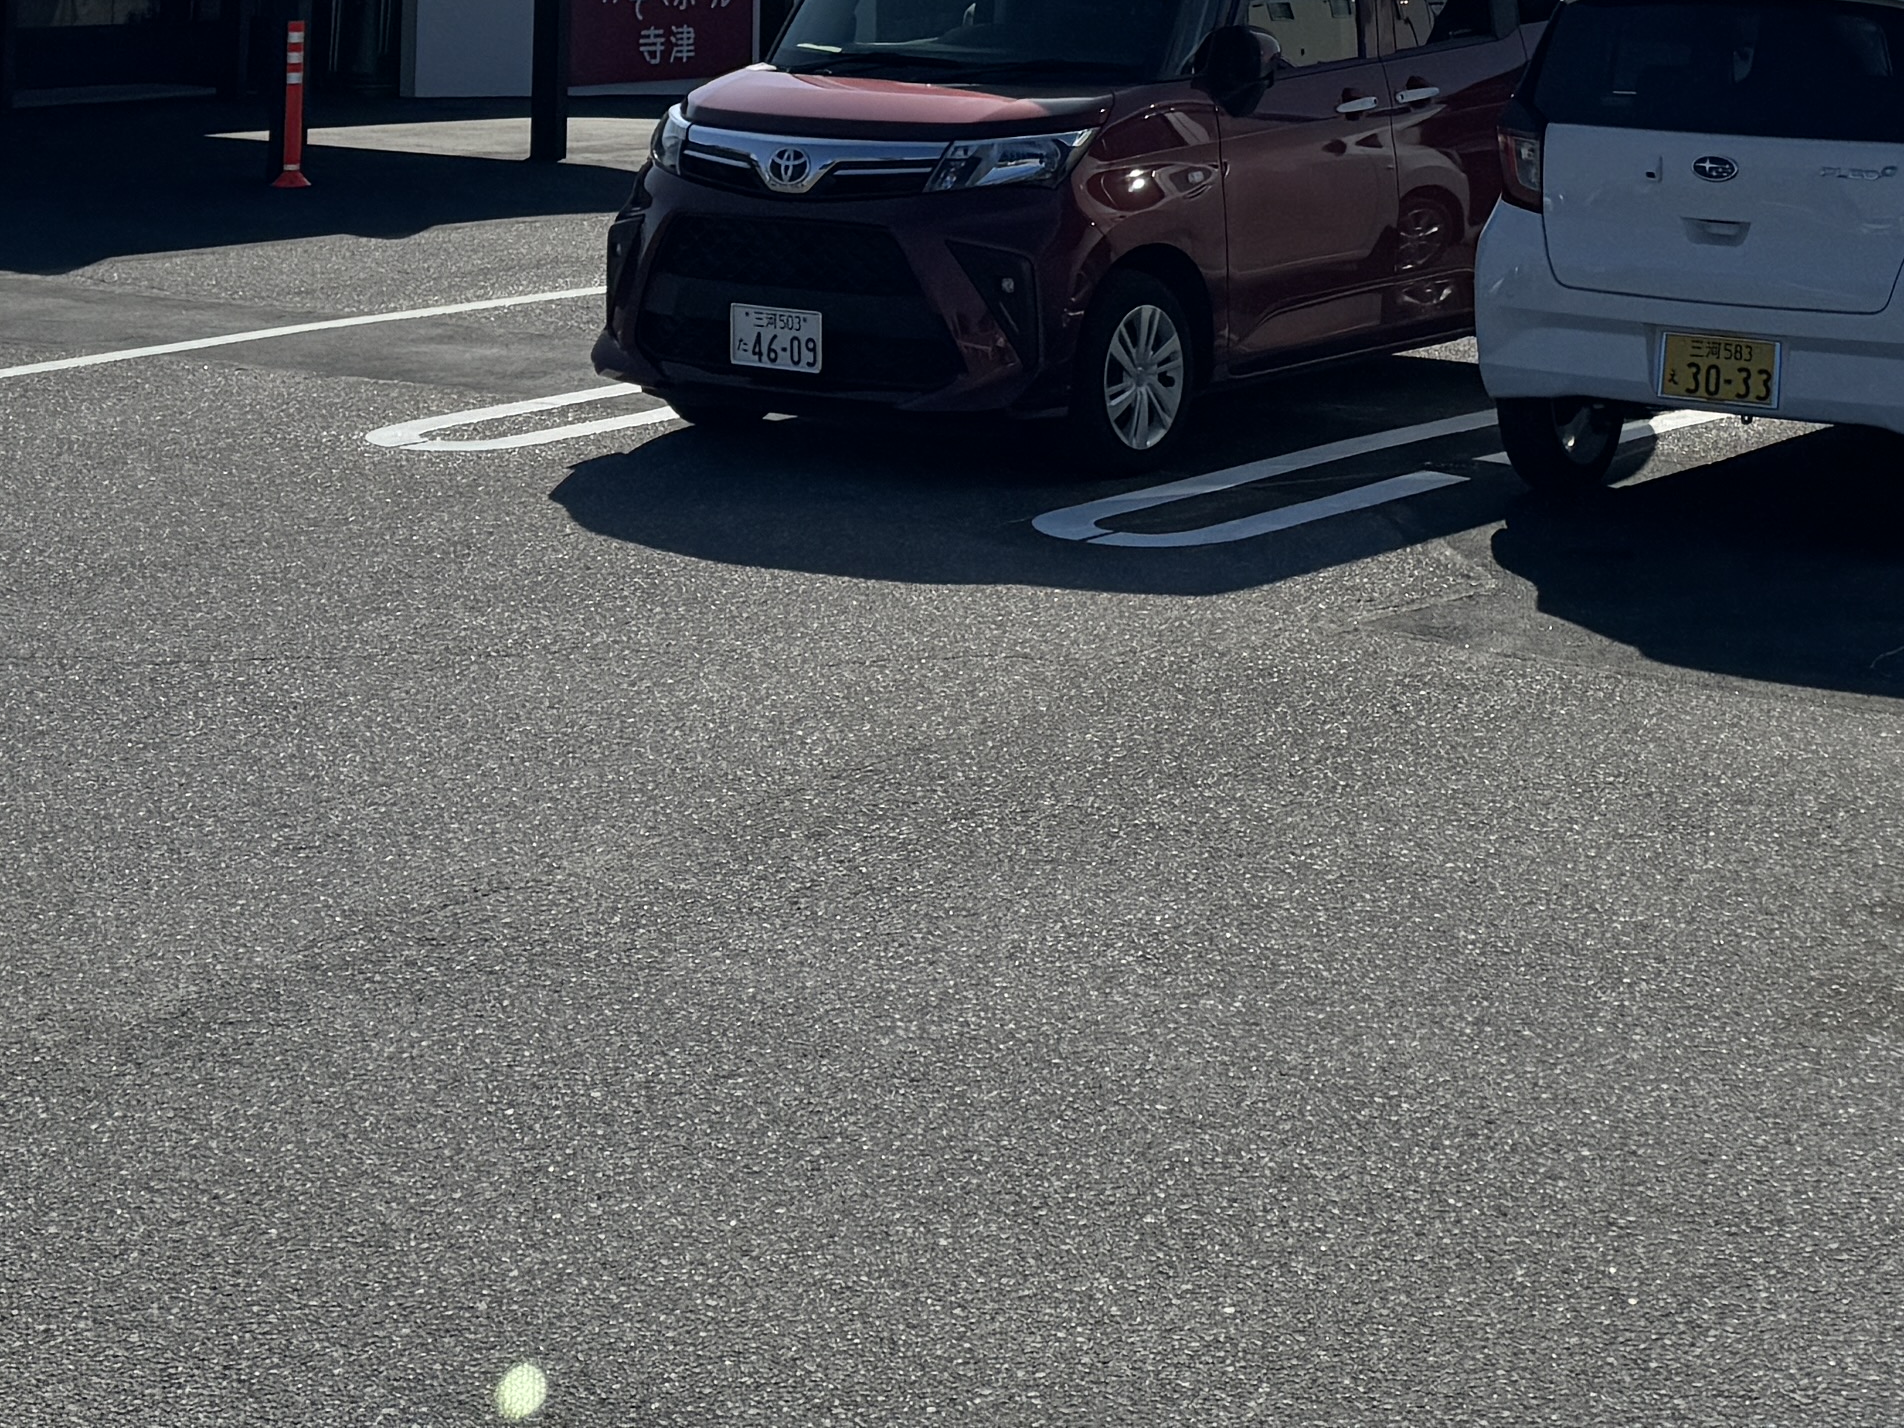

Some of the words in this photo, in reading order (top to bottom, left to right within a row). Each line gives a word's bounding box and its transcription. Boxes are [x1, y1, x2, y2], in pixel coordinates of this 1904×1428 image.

[639, 24, 696, 65] 寺津
[737, 337, 748, 352] た
[751, 331, 818, 367] 46-09
[1685, 362, 1773, 401] 30-33
